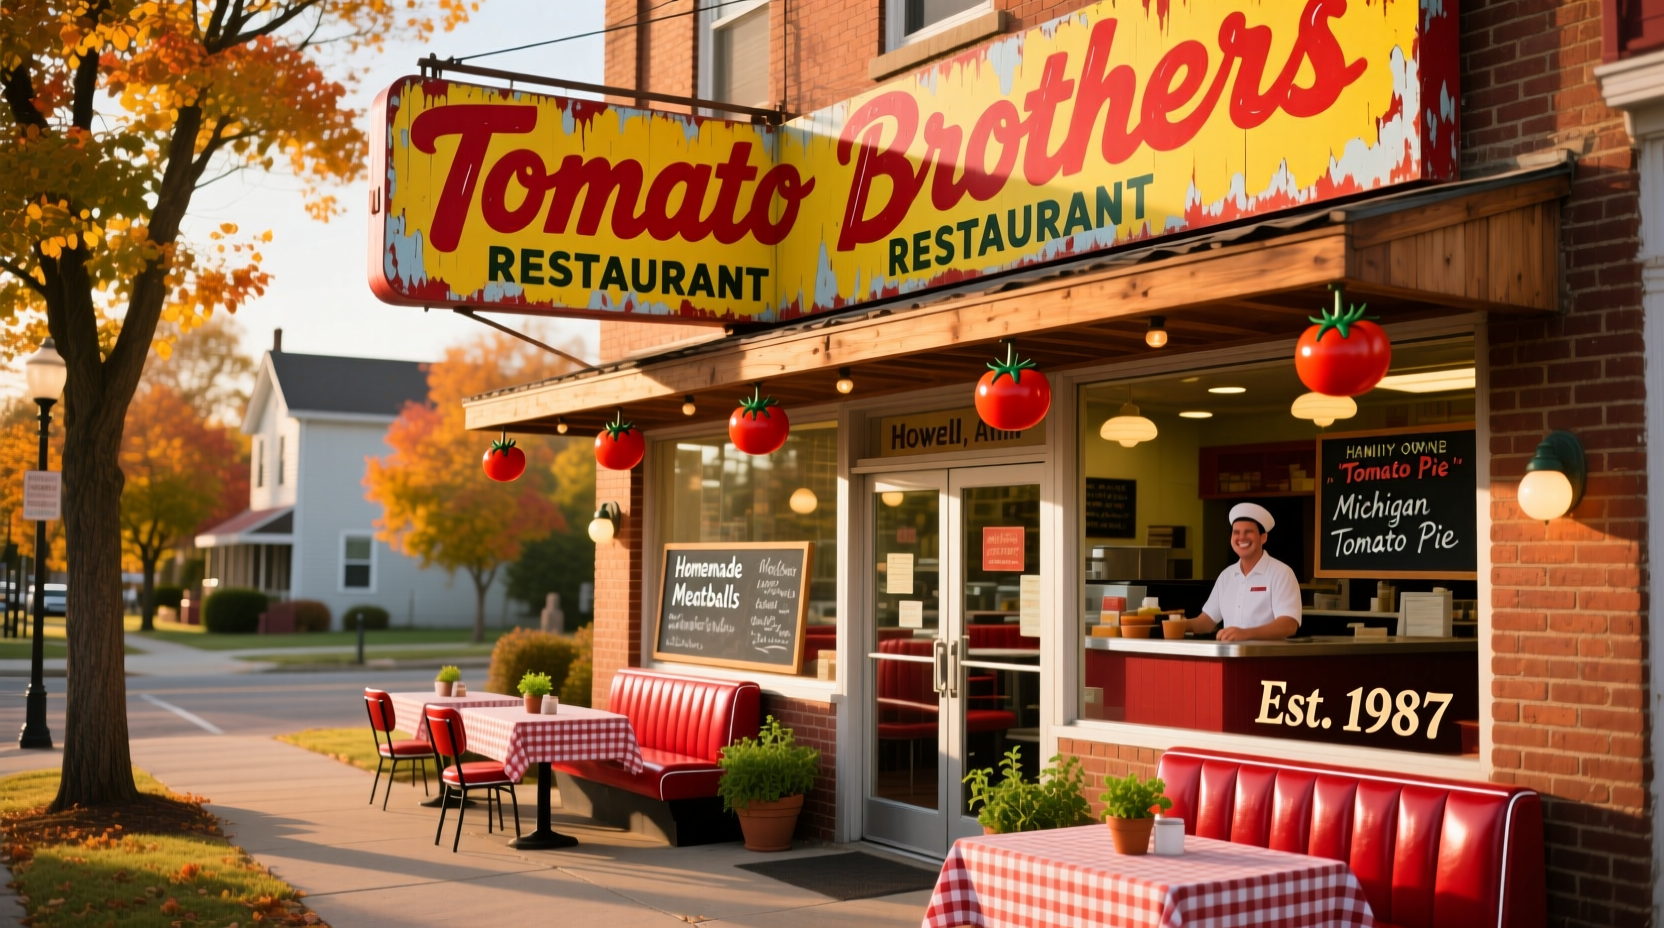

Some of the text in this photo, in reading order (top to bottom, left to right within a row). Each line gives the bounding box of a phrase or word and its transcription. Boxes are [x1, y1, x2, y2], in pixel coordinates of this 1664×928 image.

[411, 0, 1368, 253] Tomato Brothers
[888, 174, 1154, 278] RESTAURANT
[488, 245, 770, 302] RESTAURANT
[891, 418, 968, 450] Howell,
[1332, 490, 1431, 528] Michigan
[1331, 521, 1459, 558] Tomato Pie
[675, 555, 743, 579] Homemade
[672, 582, 740, 609] Meatballs
[1254, 679, 1454, 740] Est. 1987
